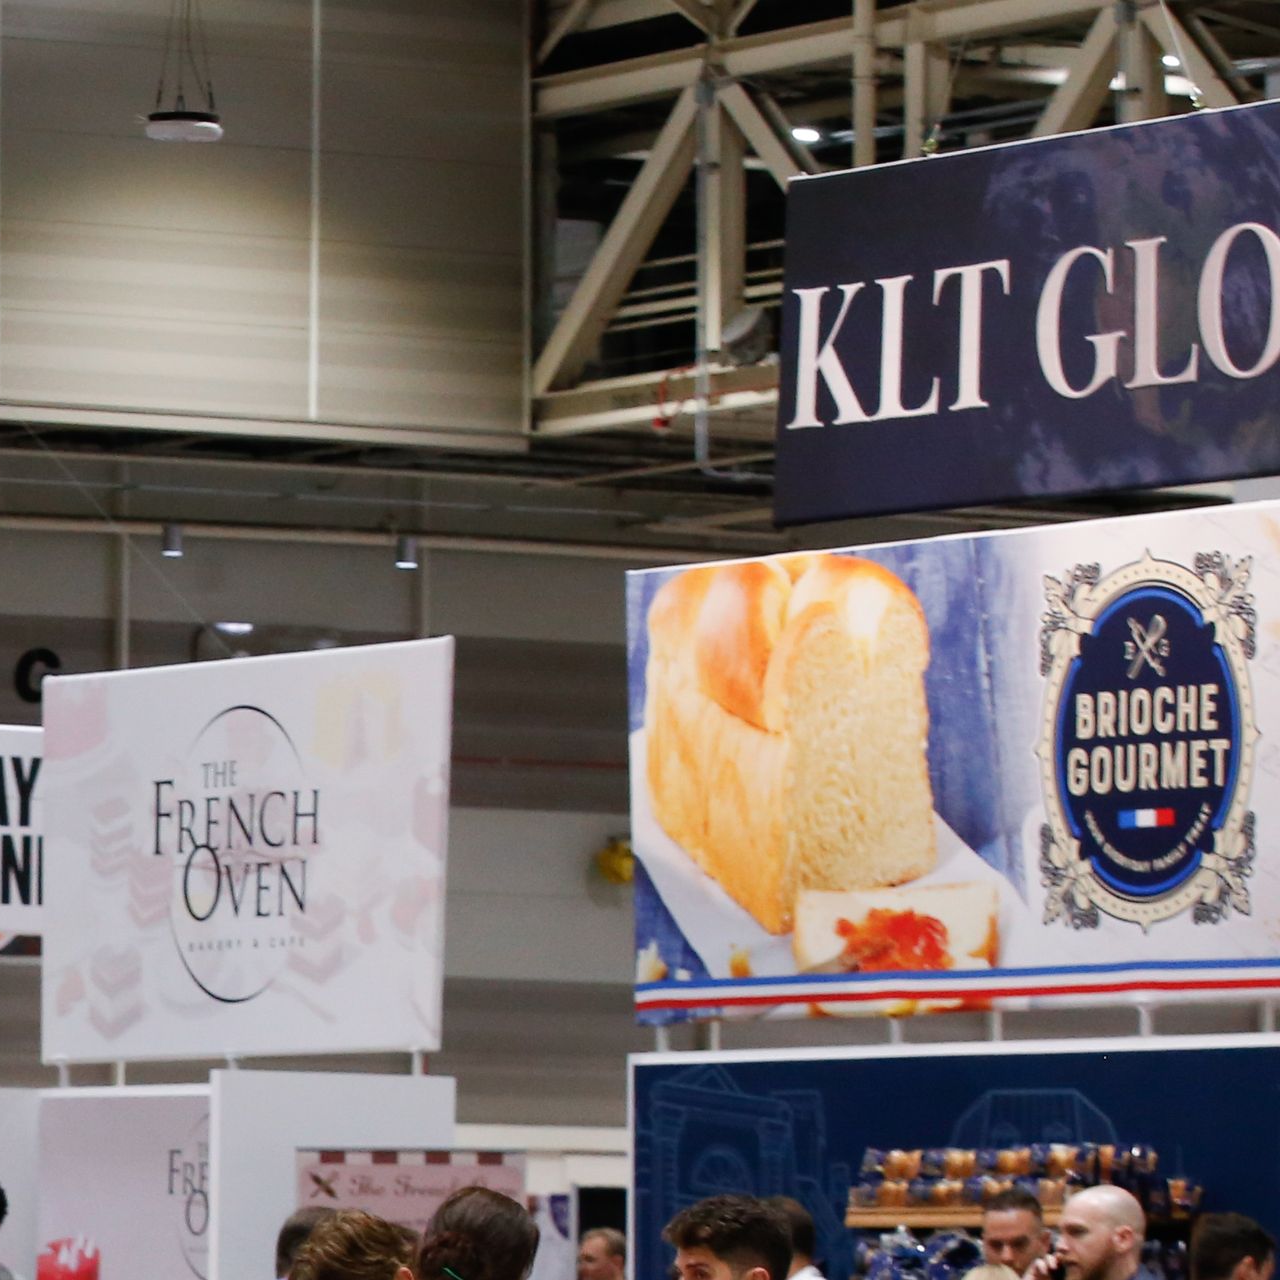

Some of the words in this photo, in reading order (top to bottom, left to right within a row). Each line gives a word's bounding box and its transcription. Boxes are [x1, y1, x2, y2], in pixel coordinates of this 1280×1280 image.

[785, 258, 1011, 431] KLT
[1035, 221, 1280, 400] GLO
[1075, 683, 1220, 740] BRIOCHE
[201, 760, 238, 789] THE
[1066, 738, 1231, 797] GOURMET
[152, 779, 320, 856] FRENCH
[183, 844, 308, 922] OVEN
